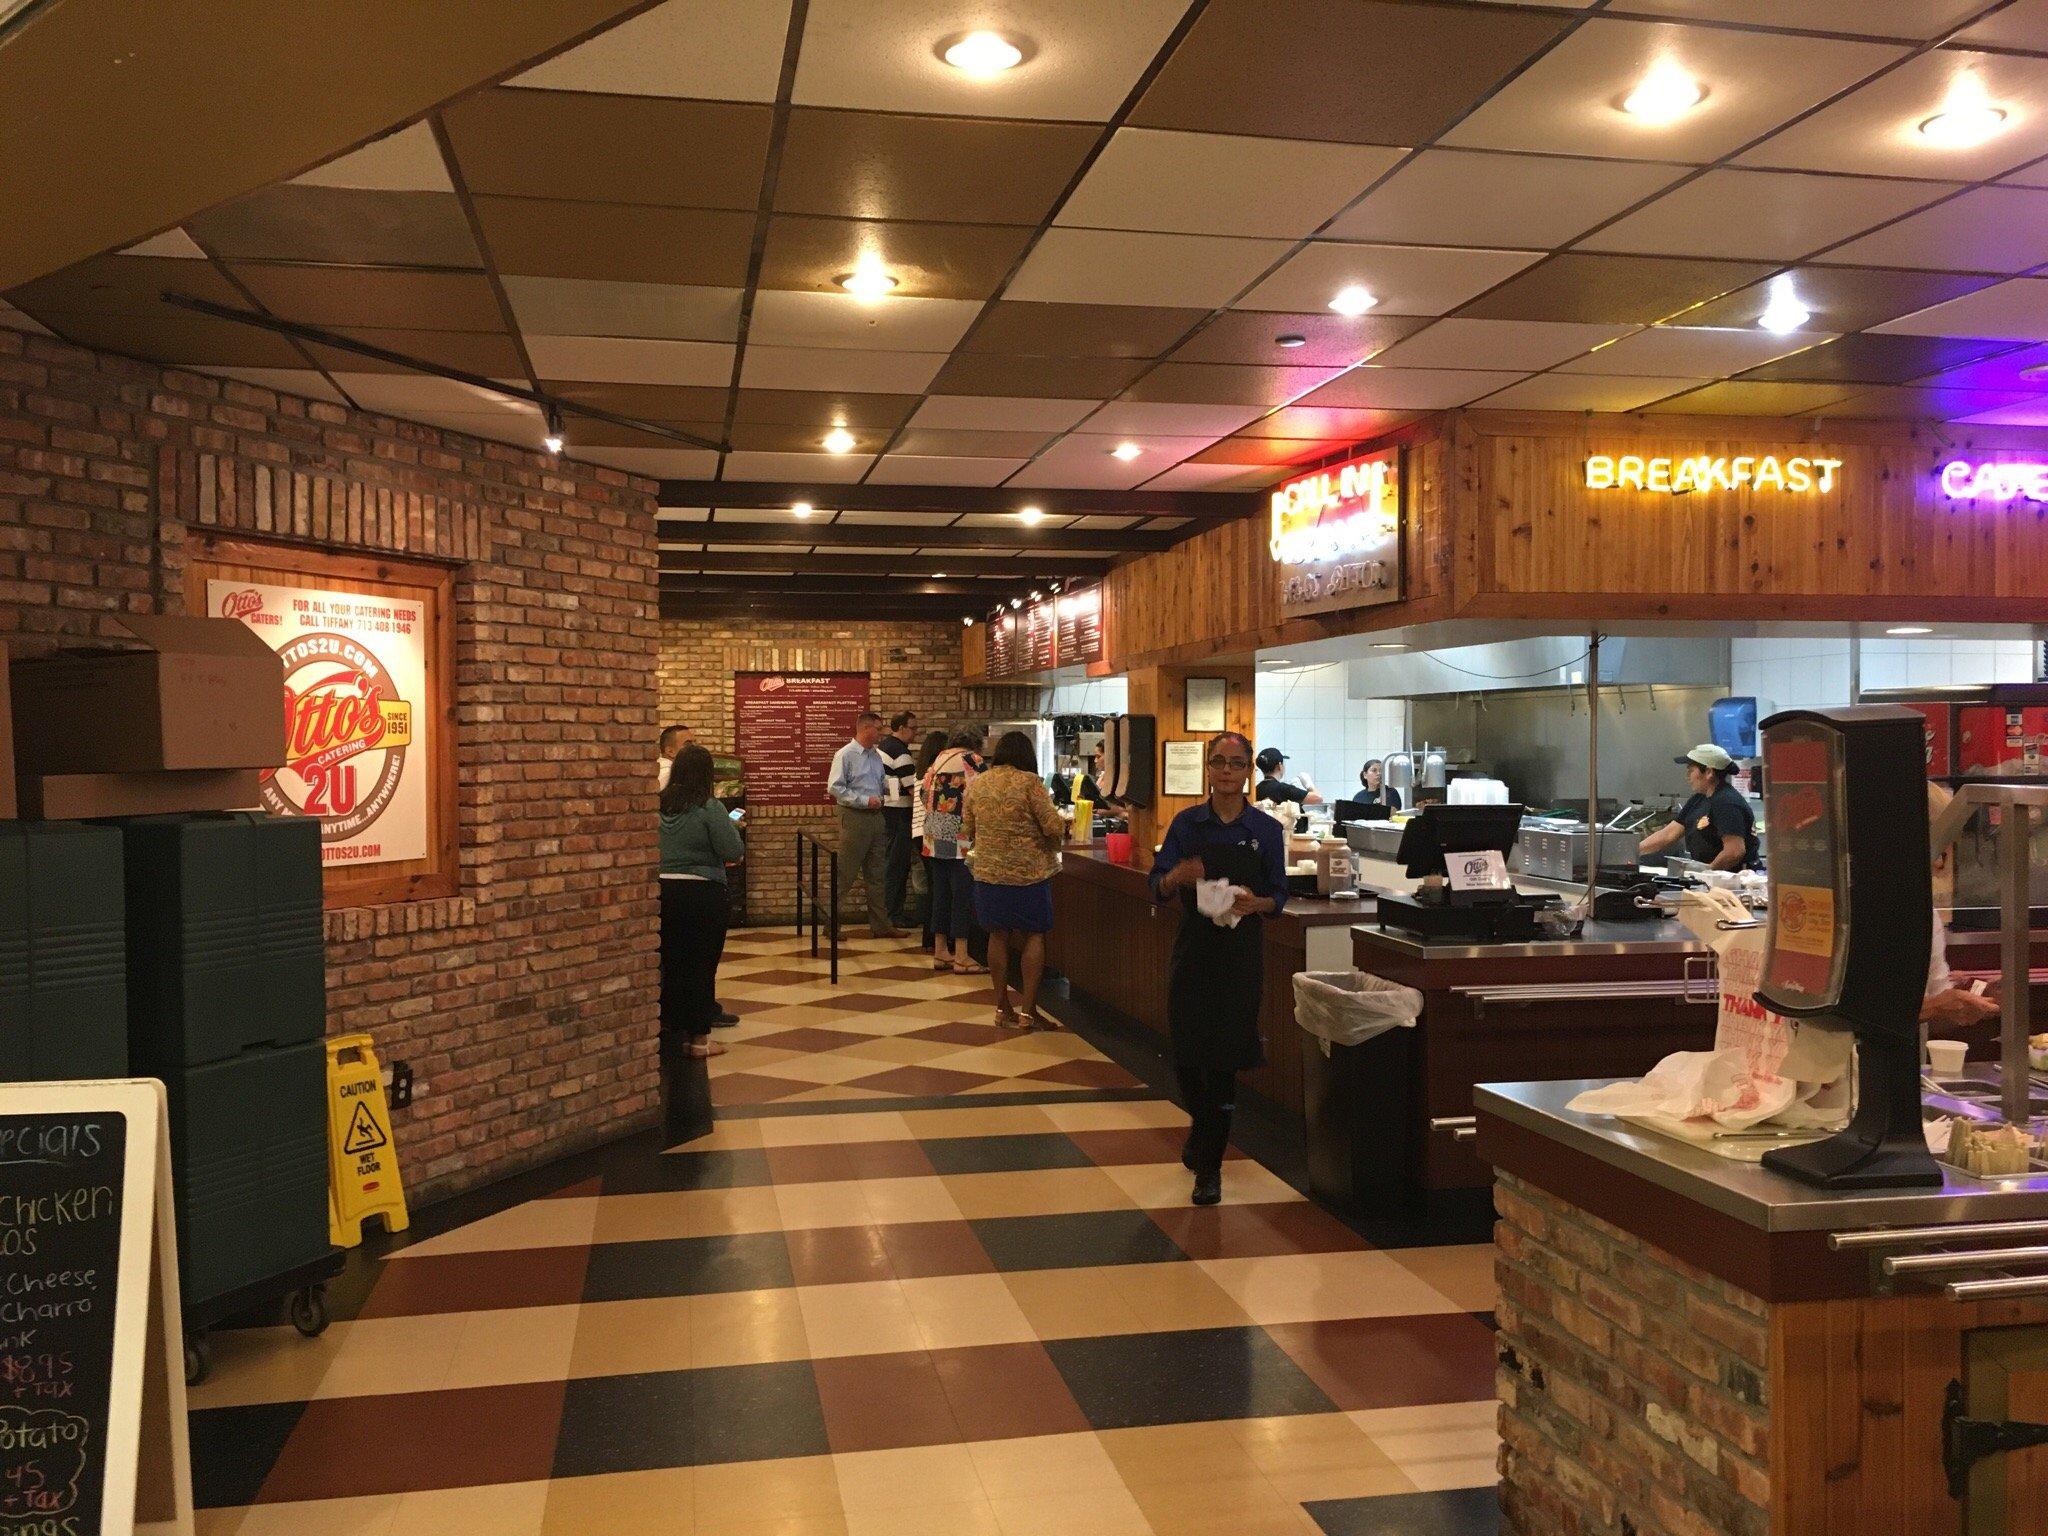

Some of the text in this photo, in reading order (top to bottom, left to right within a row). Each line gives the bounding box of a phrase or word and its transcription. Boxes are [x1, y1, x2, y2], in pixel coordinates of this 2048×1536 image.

[1585, 455, 1843, 494] BREAKFAST
[222, 588, 264, 618] Otto's
[293, 599, 416, 622] FOR ALL YOUR CATERING NEEDS
[251, 612, 283, 626] CATERS!
[300, 614, 412, 635] CALL TIFFANY 713 408 1946
[283, 637, 380, 680] TTOS2U.COM
[387, 712, 408, 720] SINCE
[387, 722, 408, 735] 1951
[317, 739, 367, 765] CATERING
[264, 787, 284, 811] ANY
[303, 763, 357, 816] 2U
[340, 1079, 377, 1098] CAUTION
[359, 1152, 375, 1162] WET
[357, 1162, 381, 1176] FLOOR
